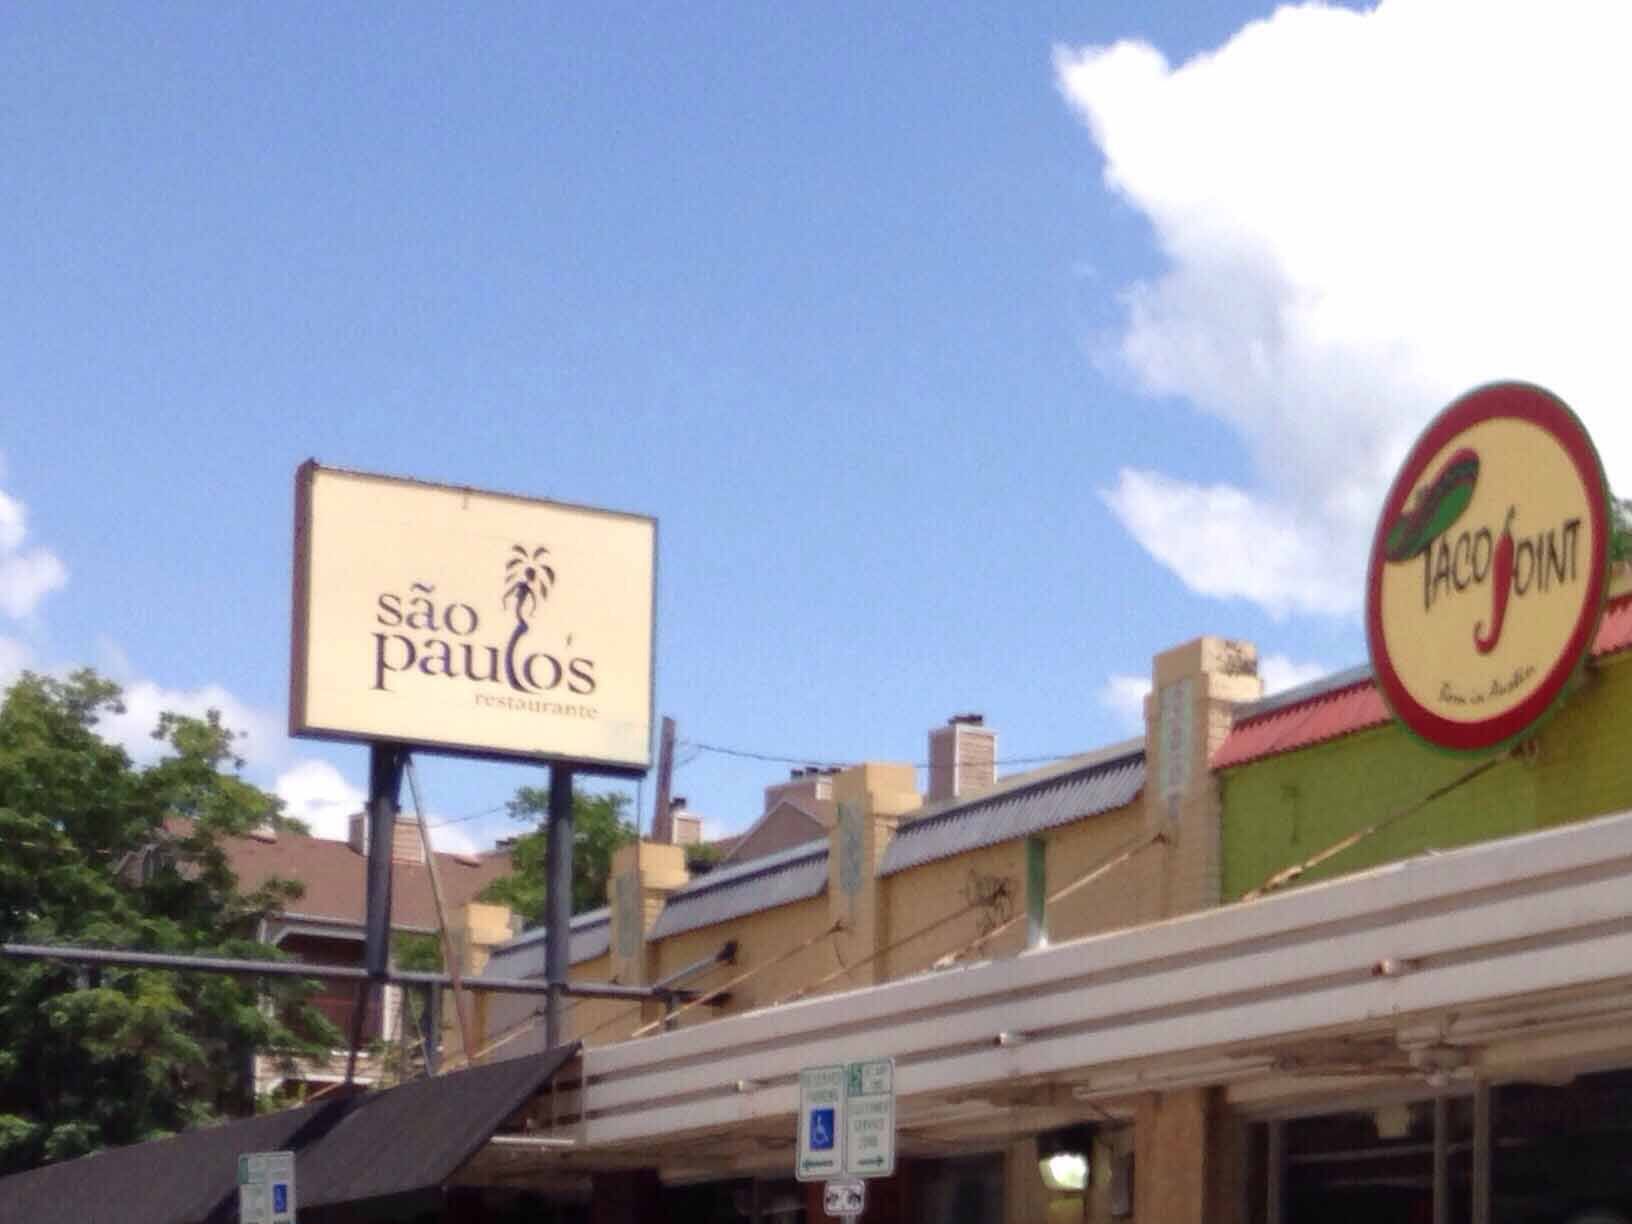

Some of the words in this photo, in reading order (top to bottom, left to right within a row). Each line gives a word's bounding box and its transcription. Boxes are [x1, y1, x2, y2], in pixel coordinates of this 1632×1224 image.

[1418, 527, 1493, 613] TACO
[1474, 504, 1581, 654] JOINT
[376, 580, 479, 636] são
[473, 691, 600, 720] restaurante
